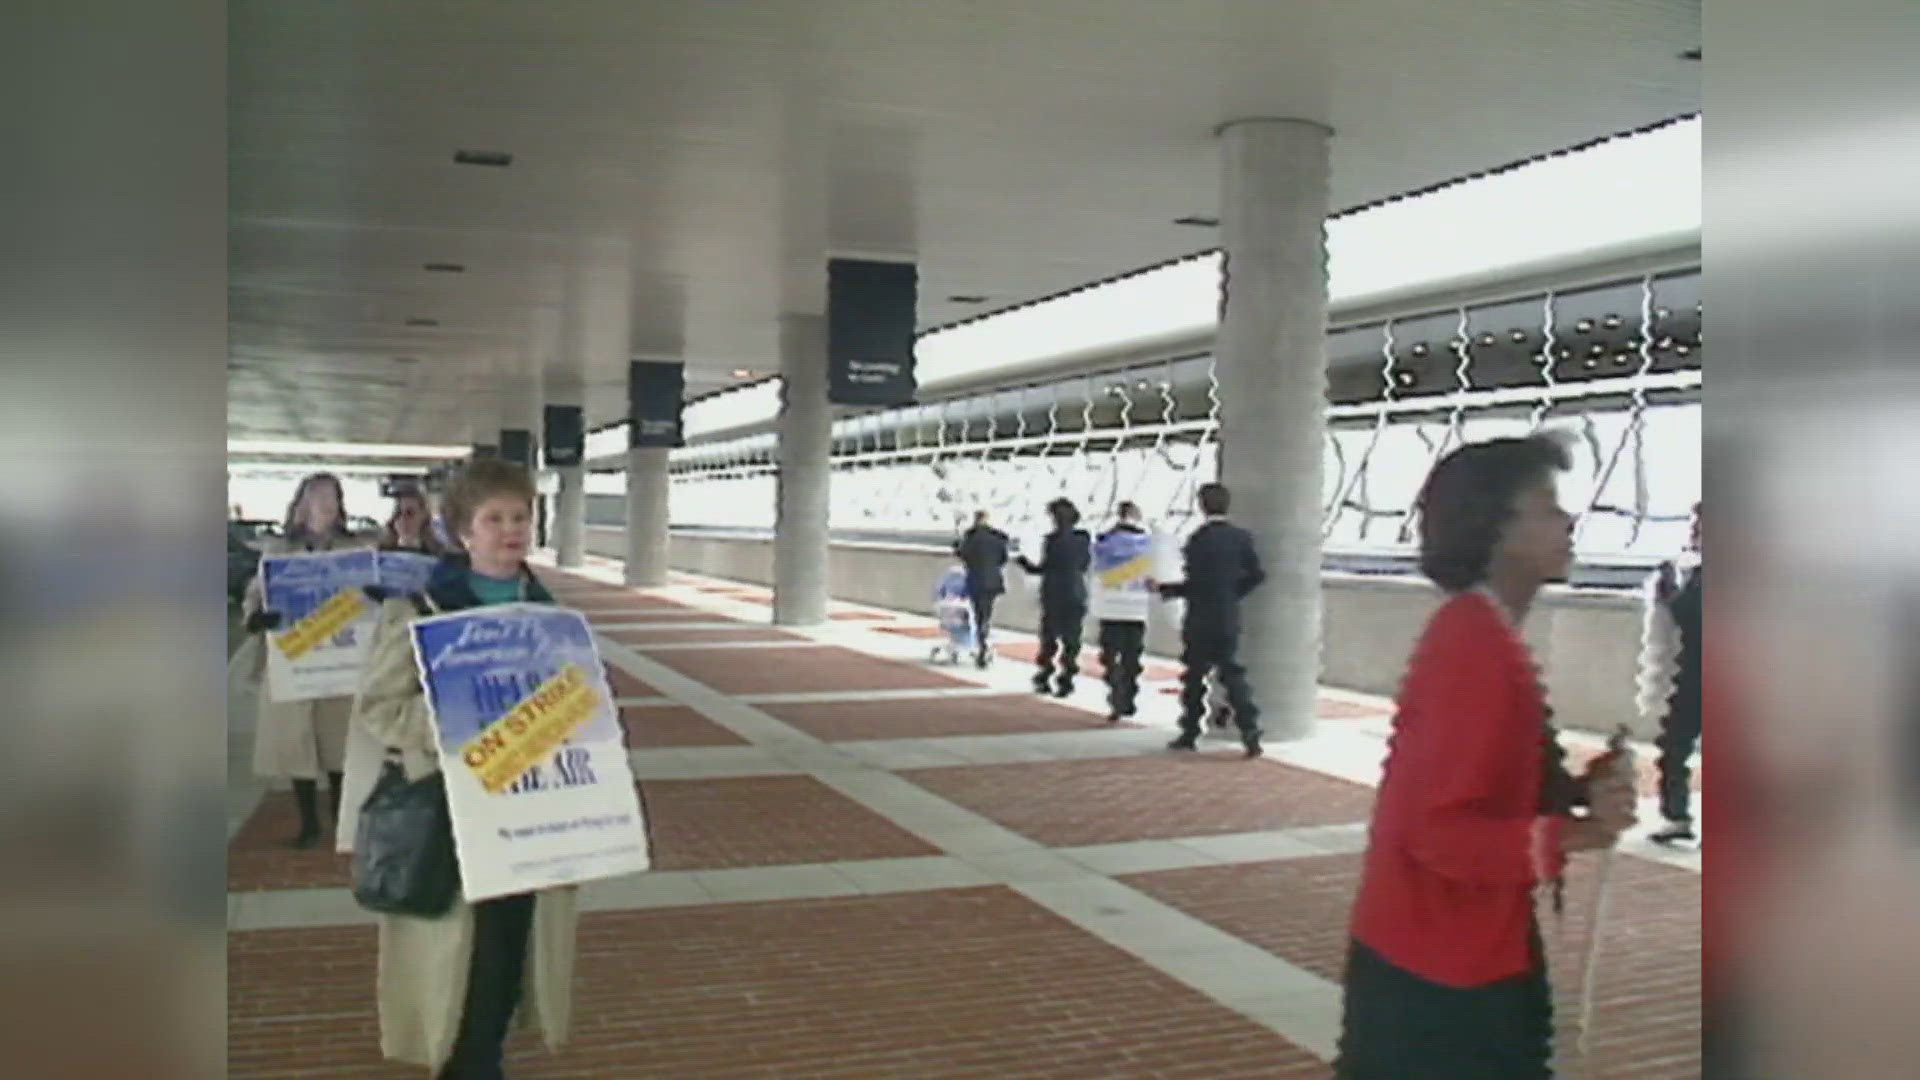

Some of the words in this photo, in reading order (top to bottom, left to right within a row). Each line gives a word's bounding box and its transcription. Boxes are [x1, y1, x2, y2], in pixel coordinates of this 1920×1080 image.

[463, 729, 505, 768] ON
[505, 664, 580, 736] STRIKE
[553, 747, 599, 786] AIR
